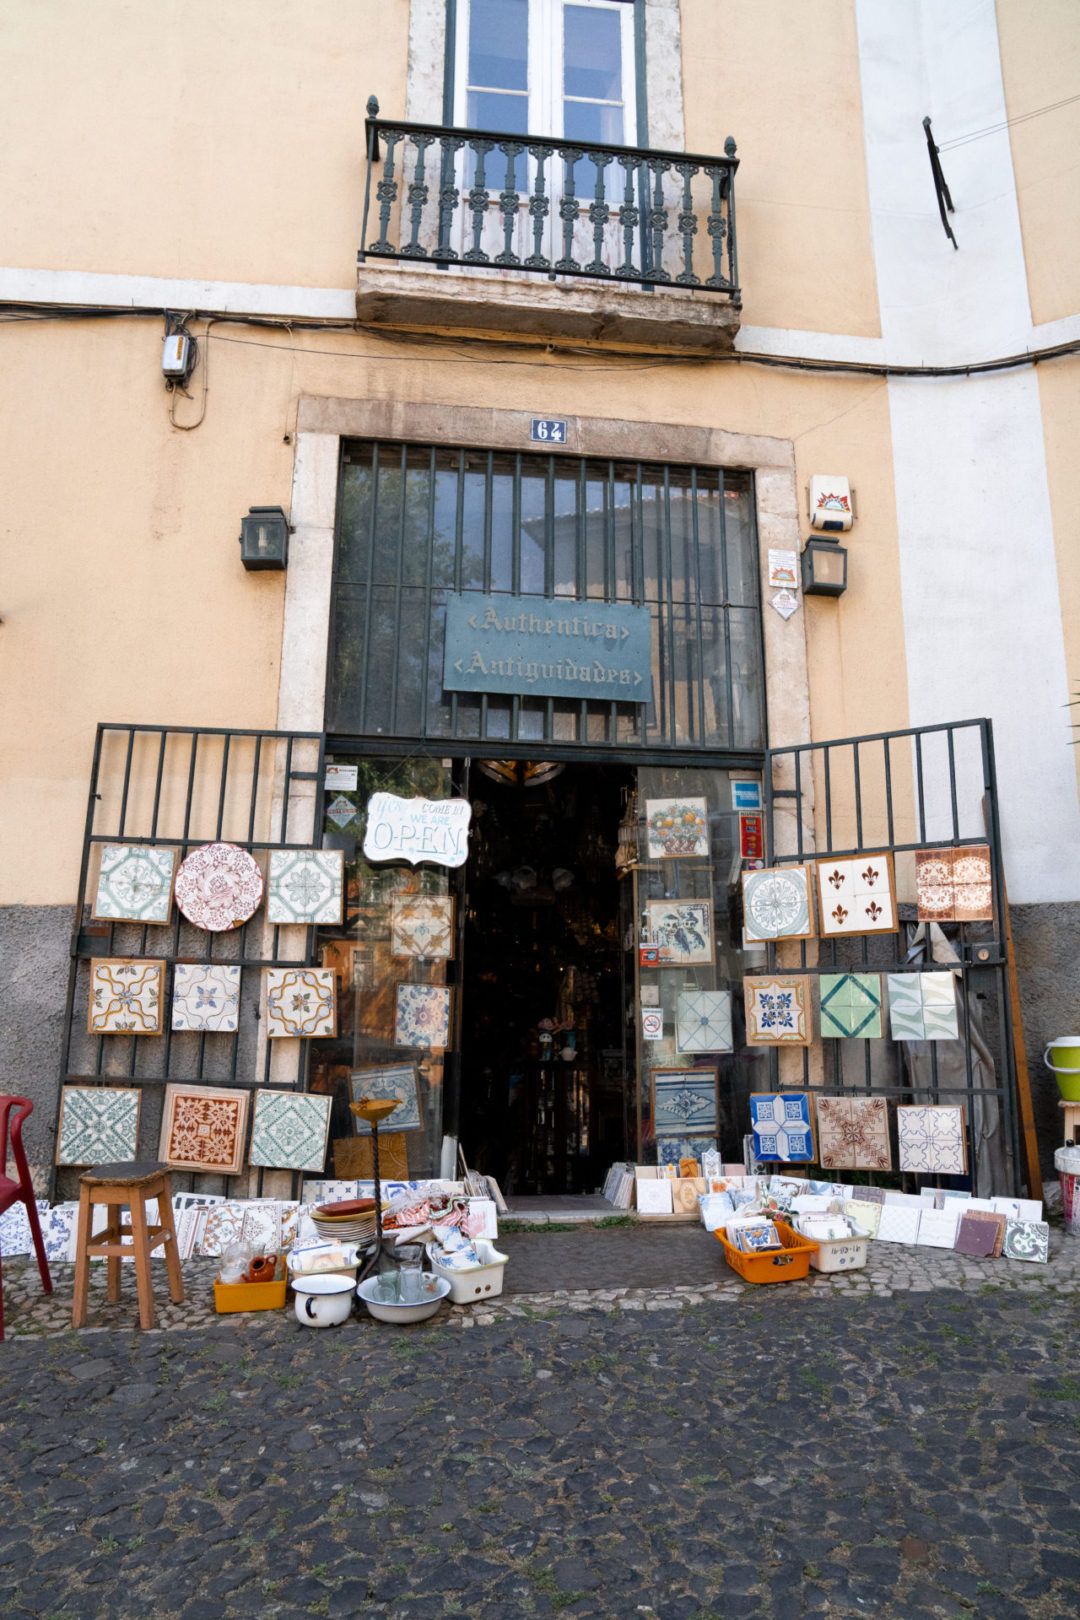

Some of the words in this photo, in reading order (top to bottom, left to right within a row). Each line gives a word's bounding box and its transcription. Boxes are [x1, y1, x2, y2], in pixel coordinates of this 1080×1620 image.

[537, 421, 562, 441] 64
[410, 814, 428, 824] WE
[431, 815, 450, 825] ARE
